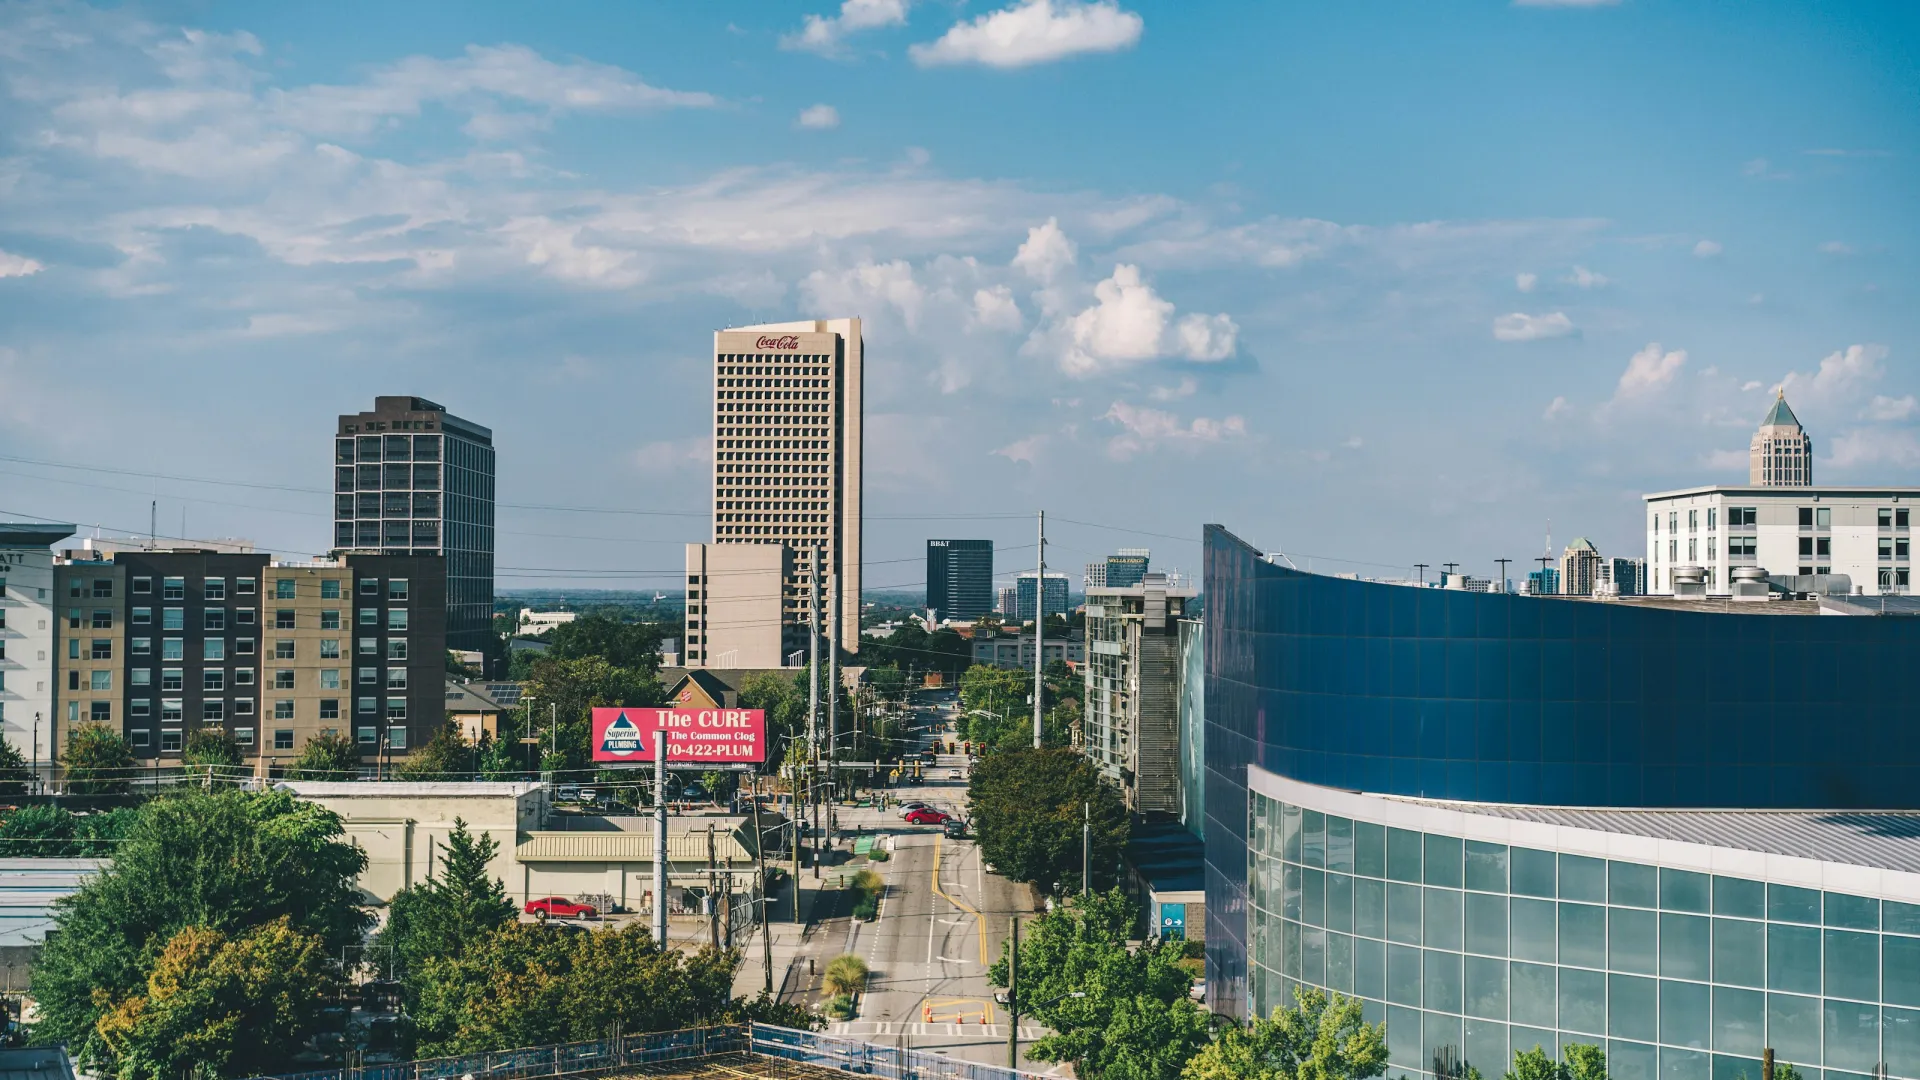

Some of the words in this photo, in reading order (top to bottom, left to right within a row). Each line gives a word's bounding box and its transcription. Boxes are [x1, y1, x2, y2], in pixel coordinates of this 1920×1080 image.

[656, 711, 692, 727] The
[698, 711, 752, 727] CURE
[607, 730, 638, 739] Superior
[671, 732, 688, 740] The
[690, 732, 732, 741] Common
[734, 732, 756, 742] Clog
[608, 741, 637, 749] PLUMBING
[655, 743, 753, 756] 70-422-PLUM
